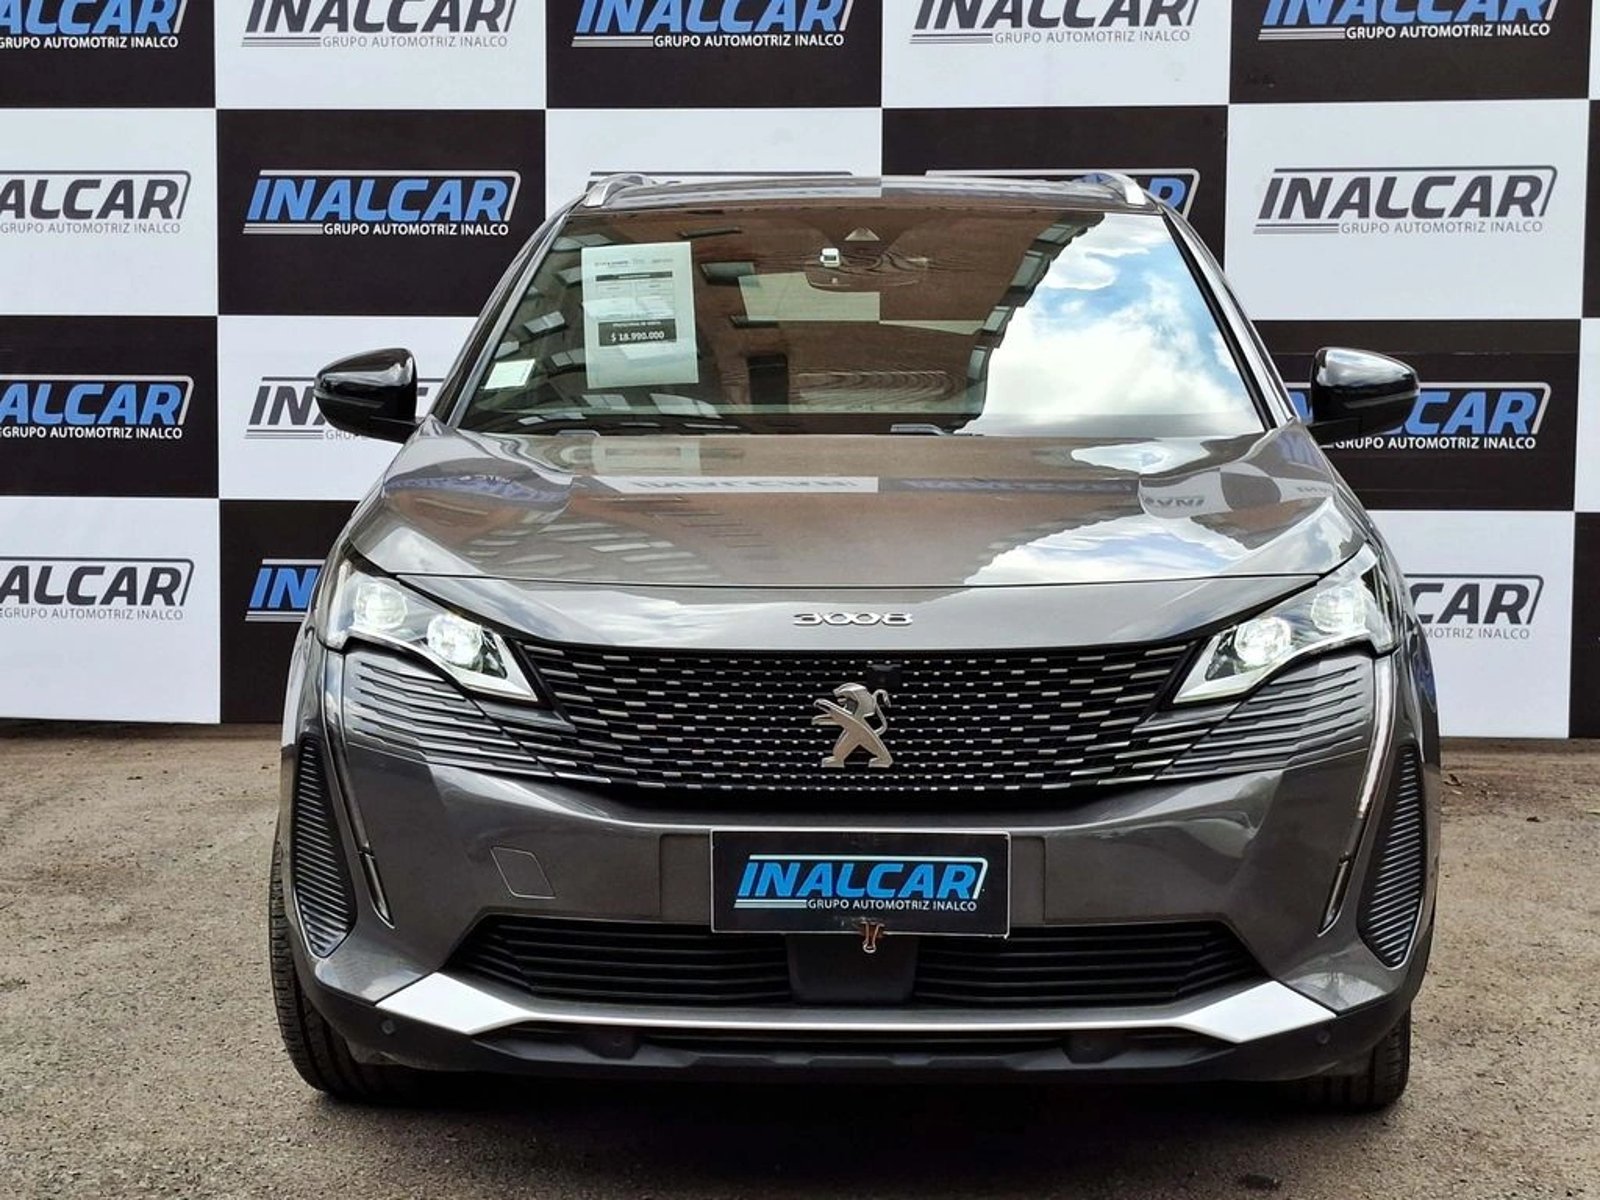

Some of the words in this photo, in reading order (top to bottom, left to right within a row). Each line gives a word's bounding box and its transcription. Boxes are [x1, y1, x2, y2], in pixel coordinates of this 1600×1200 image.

[245, 0, 503, 33] INALCAR
[575, 0, 844, 33] INALCAR
[914, 0, 1187, 29] INALCAR
[995, 32, 1041, 44] GRUPO
[1046, 31, 1135, 43] AUTOMOTRIZ
[1140, 30, 1190, 42] INALCO
[1346, 26, 1396, 39] GRUPO
[1400, 25, 1492, 38] AUTOMOTRIZ
[1497, 23, 1550, 36] INALCO
[44, 37, 127, 48] AUTOMOTRIZ
[131, 36, 179, 48] INALCO
[323, 37, 367, 48] GRUPO
[372, 37, 456, 47] AUTOMOTRIZ
[461, 37, 508, 47] INALCO
[654, 35, 700, 47] GRUPO
[704, 35, 791, 47] AUTOMOTRIZ
[795, 34, 844, 46] INALCO
[246, 178, 509, 222] INALCAR
[1258, 175, 1543, 220] INALCAR
[1, 222, 44, 234] GRUPO
[47, 222, 130, 234] AUTOMOTRIZ
[134, 222, 181, 234] INALCO
[324, 223, 370, 236] GRUPO
[373, 223, 457, 236] AUTOMOTRIZ
[461, 223, 509, 236] INALCO
[1341, 222, 1390, 234] GRUPO
[1394, 221, 1486, 233] AUTOMOTRIZ
[1490, 220, 1543, 233] INALCO
[2, 426, 46, 439] GRUPO
[50, 426, 133, 439] AUTOMOTRIZ
[136, 427, 183, 439] INALCO
[1387, 437, 1479, 449] AUTOMOTRIZ
[1484, 437, 1537, 449] INALCO
[2, 608, 48, 619] GRUPO
[51, 608, 134, 620] AUTOMOTRIZ
[137, 609, 184, 621] INALCO
[793, 612, 913, 626] 3008
[1479, 628, 1530, 640] INALCO
[737, 862, 976, 899] INALCAR
[807, 899, 850, 910] GRUPO
[852, 899, 930, 911] AUTOMOTRIZ
[933, 900, 977, 912] INALCO
